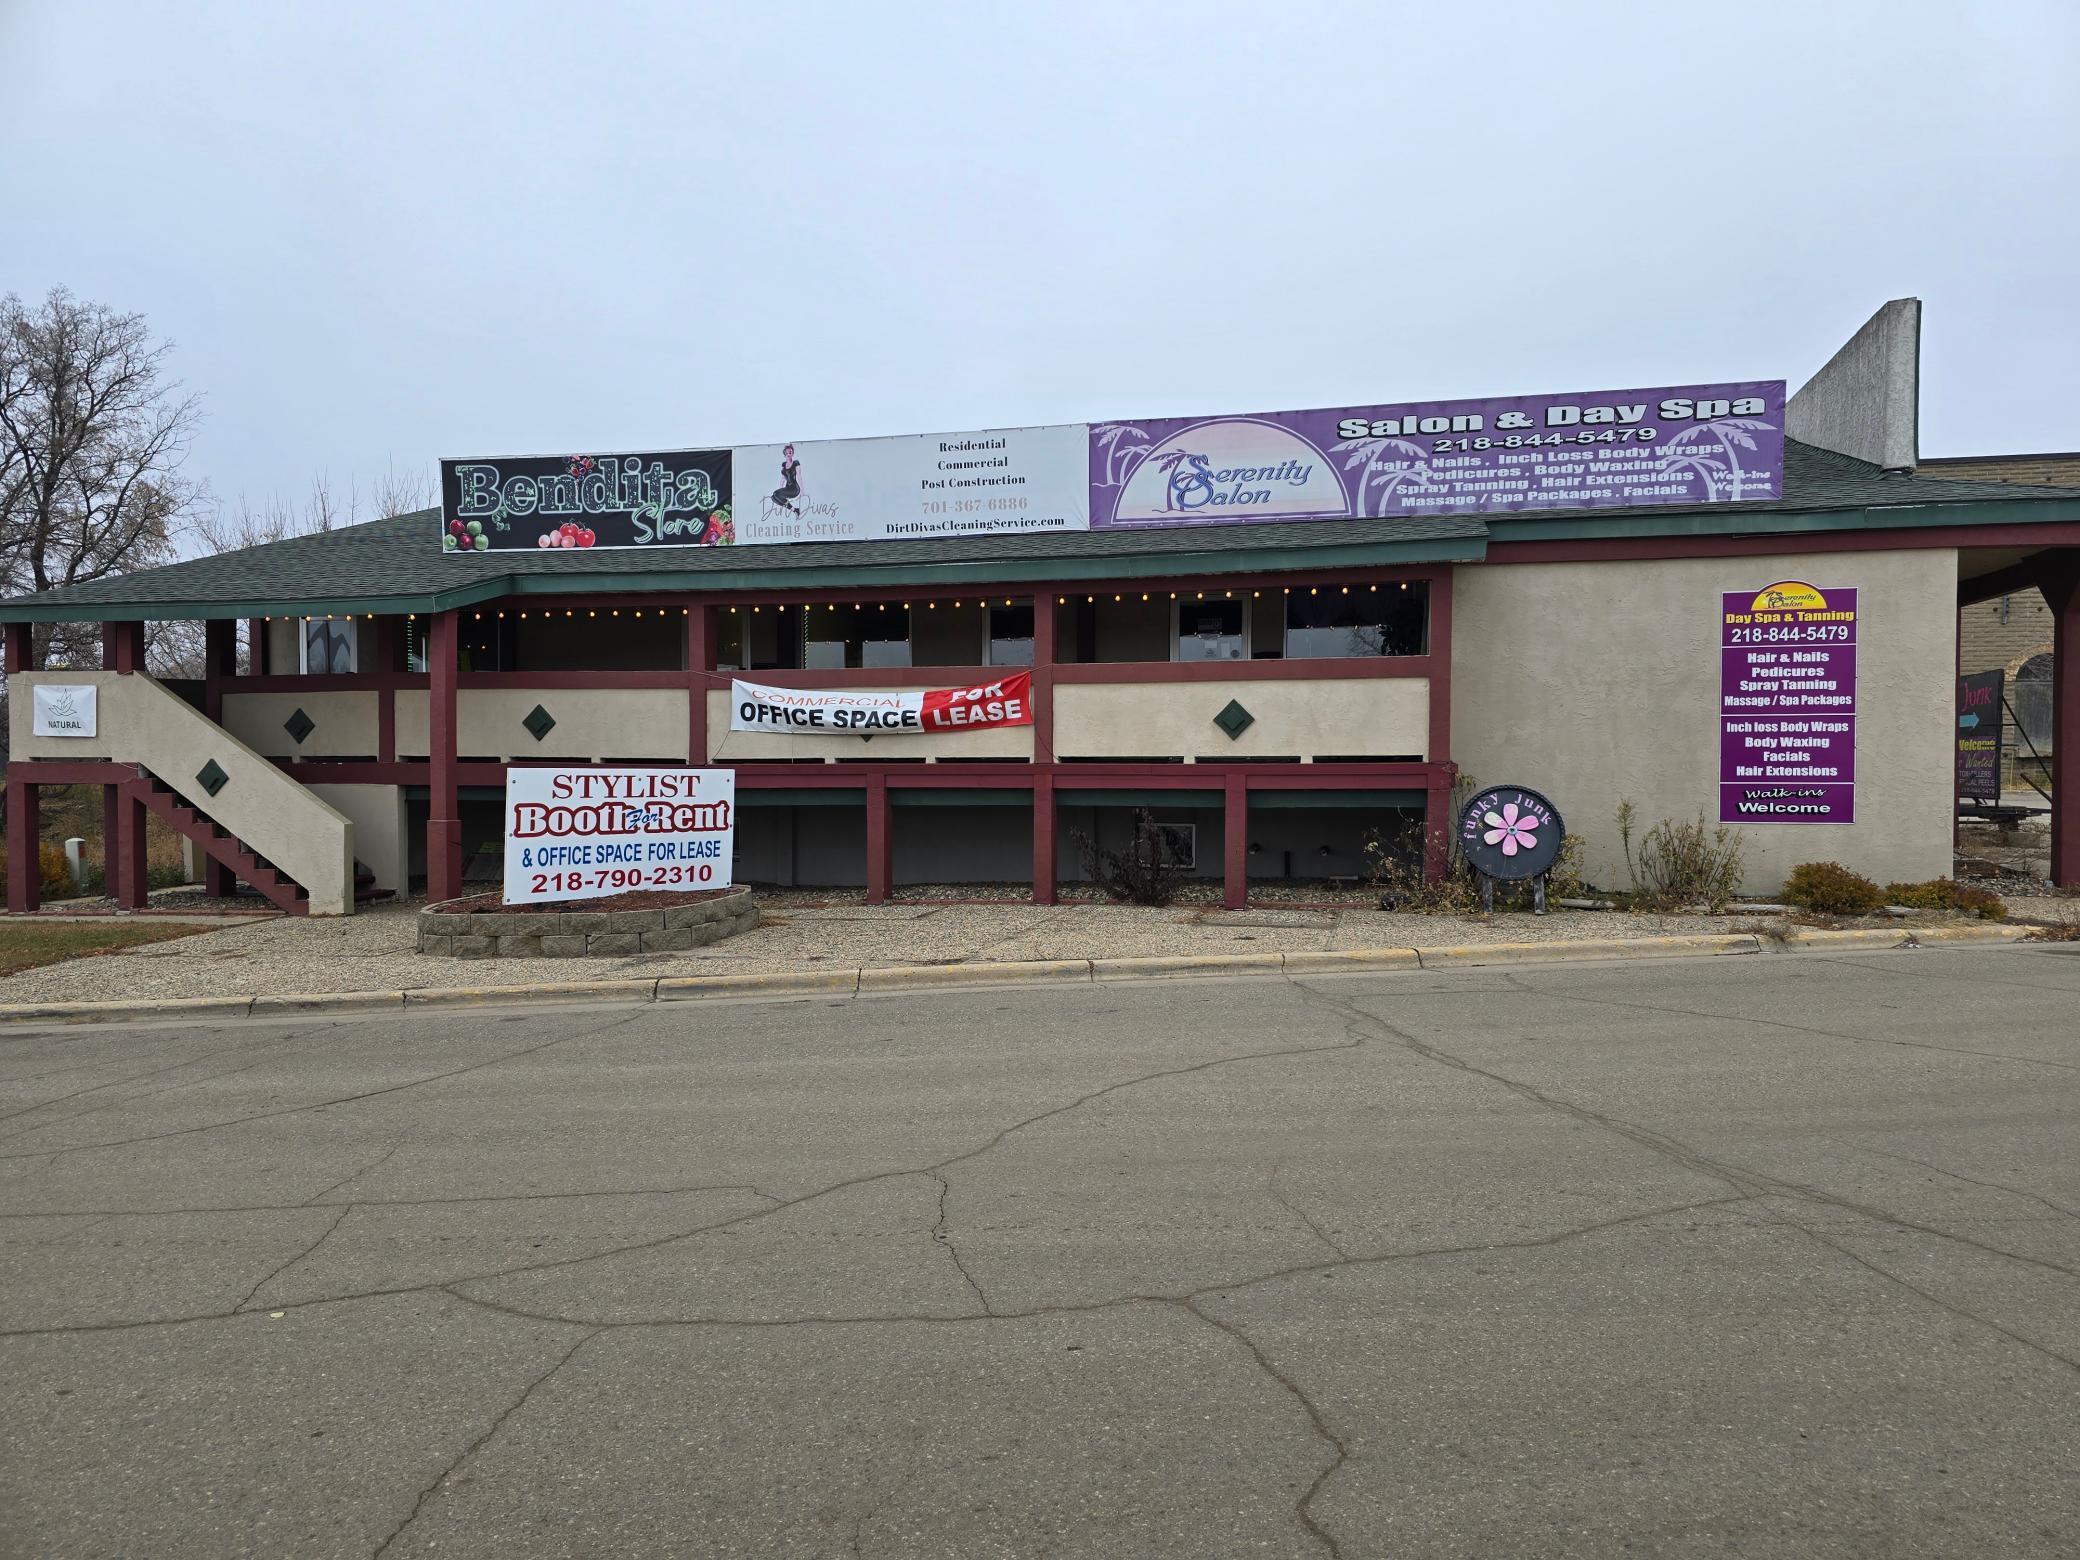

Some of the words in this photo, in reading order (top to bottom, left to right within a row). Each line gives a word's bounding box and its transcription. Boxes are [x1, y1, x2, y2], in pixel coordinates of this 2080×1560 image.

[1338, 414, 1484, 438] Salon
[1496, 411, 1535, 429] &
[1547, 403, 1648, 427] Day
[1659, 397, 1766, 420] Spa
[939, 438, 1006, 452] Residential
[1433, 428, 1658, 453] 218-844-5479
[938, 457, 1008, 471] Commercial
[1371, 460, 1410, 471] Hair
[1414, 460, 1428, 470] &
[1499, 452, 1543, 465] Inch
[1548, 449, 1594, 462] Loss
[1599, 447, 1650, 460] Body
[1655, 443, 1725, 457] Wraps
[1172, 454, 1313, 490] Serenity
[1421, 467, 1522, 482] Pedicures
[1535, 462, 1585, 476] Body
[1589, 459, 1669, 473] Waxing
[456, 457, 718, 517] Bendita
[922, 479, 945, 490] Post
[949, 475, 1026, 488] Construction
[1176, 475, 1272, 508] Salon
[1396, 482, 1450, 495] Spray
[1453, 478, 1529, 492] Tanning
[1542, 476, 1581, 488] Hair
[1586, 470, 1695, 486] Extensions
[922, 496, 1028, 515] 701-367-6886
[1402, 493, 1477, 507] Massage
[1480, 493, 1489, 504] /
[1492, 492, 1524, 504] Spa
[1528, 488, 1612, 501] Packages
[1623, 484, 1688, 497] Facials
[796, 494, 840, 521] Divas
[631, 499, 704, 544] Store
[745, 522, 801, 538] Cleaning
[806, 520, 854, 536] Service
[886, 516, 1066, 534] DirtDivasCleaningService.com
[1726, 613, 1752, 623] Day
[1754, 612, 1781, 623] Spa
[1784, 613, 1794, 622] &
[1797, 611, 1855, 621] Tanning
[1731, 626, 1849, 643] 218-844-5479
[1747, 652, 1777, 663] Hair
[1780, 653, 1790, 663] &
[1793, 651, 1830, 662] Nails
[1751, 667, 1825, 678] Pedicures
[950, 682, 1004, 703] FOR
[1740, 680, 1779, 691] Spray
[1781, 679, 1837, 691] Tanning
[751, 689, 905, 709] COMMERCIAL
[1724, 696, 1771, 706] Massage
[1772, 695, 1778, 706] /
[1779, 695, 1800, 706] Spa
[1801, 695, 1852, 706] Packages
[740, 702, 824, 728] OFFICE
[833, 708, 918, 729] SPACE
[933, 699, 1022, 727] LEASE
[48, 720, 82, 729] NATURAL
[1726, 722, 1752, 732] Inch
[1780, 721, 1809, 733] Body
[1811, 721, 1849, 732] Wraps
[1744, 737, 1778, 748] Body
[1780, 736, 1830, 748] Waxing
[1763, 751, 1811, 762] Facials
[1736, 766, 1764, 776] Hair
[1766, 765, 1838, 776] Extensions
[552, 775, 701, 800] STYLIST
[1739, 802, 1831, 813] Welcome
[514, 802, 639, 838] Booth
[626, 808, 660, 830] For
[644, 800, 730, 833] Rent
[522, 847, 533, 868] &
[537, 844, 592, 867] OFFICE
[595, 843, 642, 864] SPACE
[648, 842, 676, 862] FOR
[679, 840, 721, 860] LEASE
[531, 864, 712, 894] 218-790-2310
